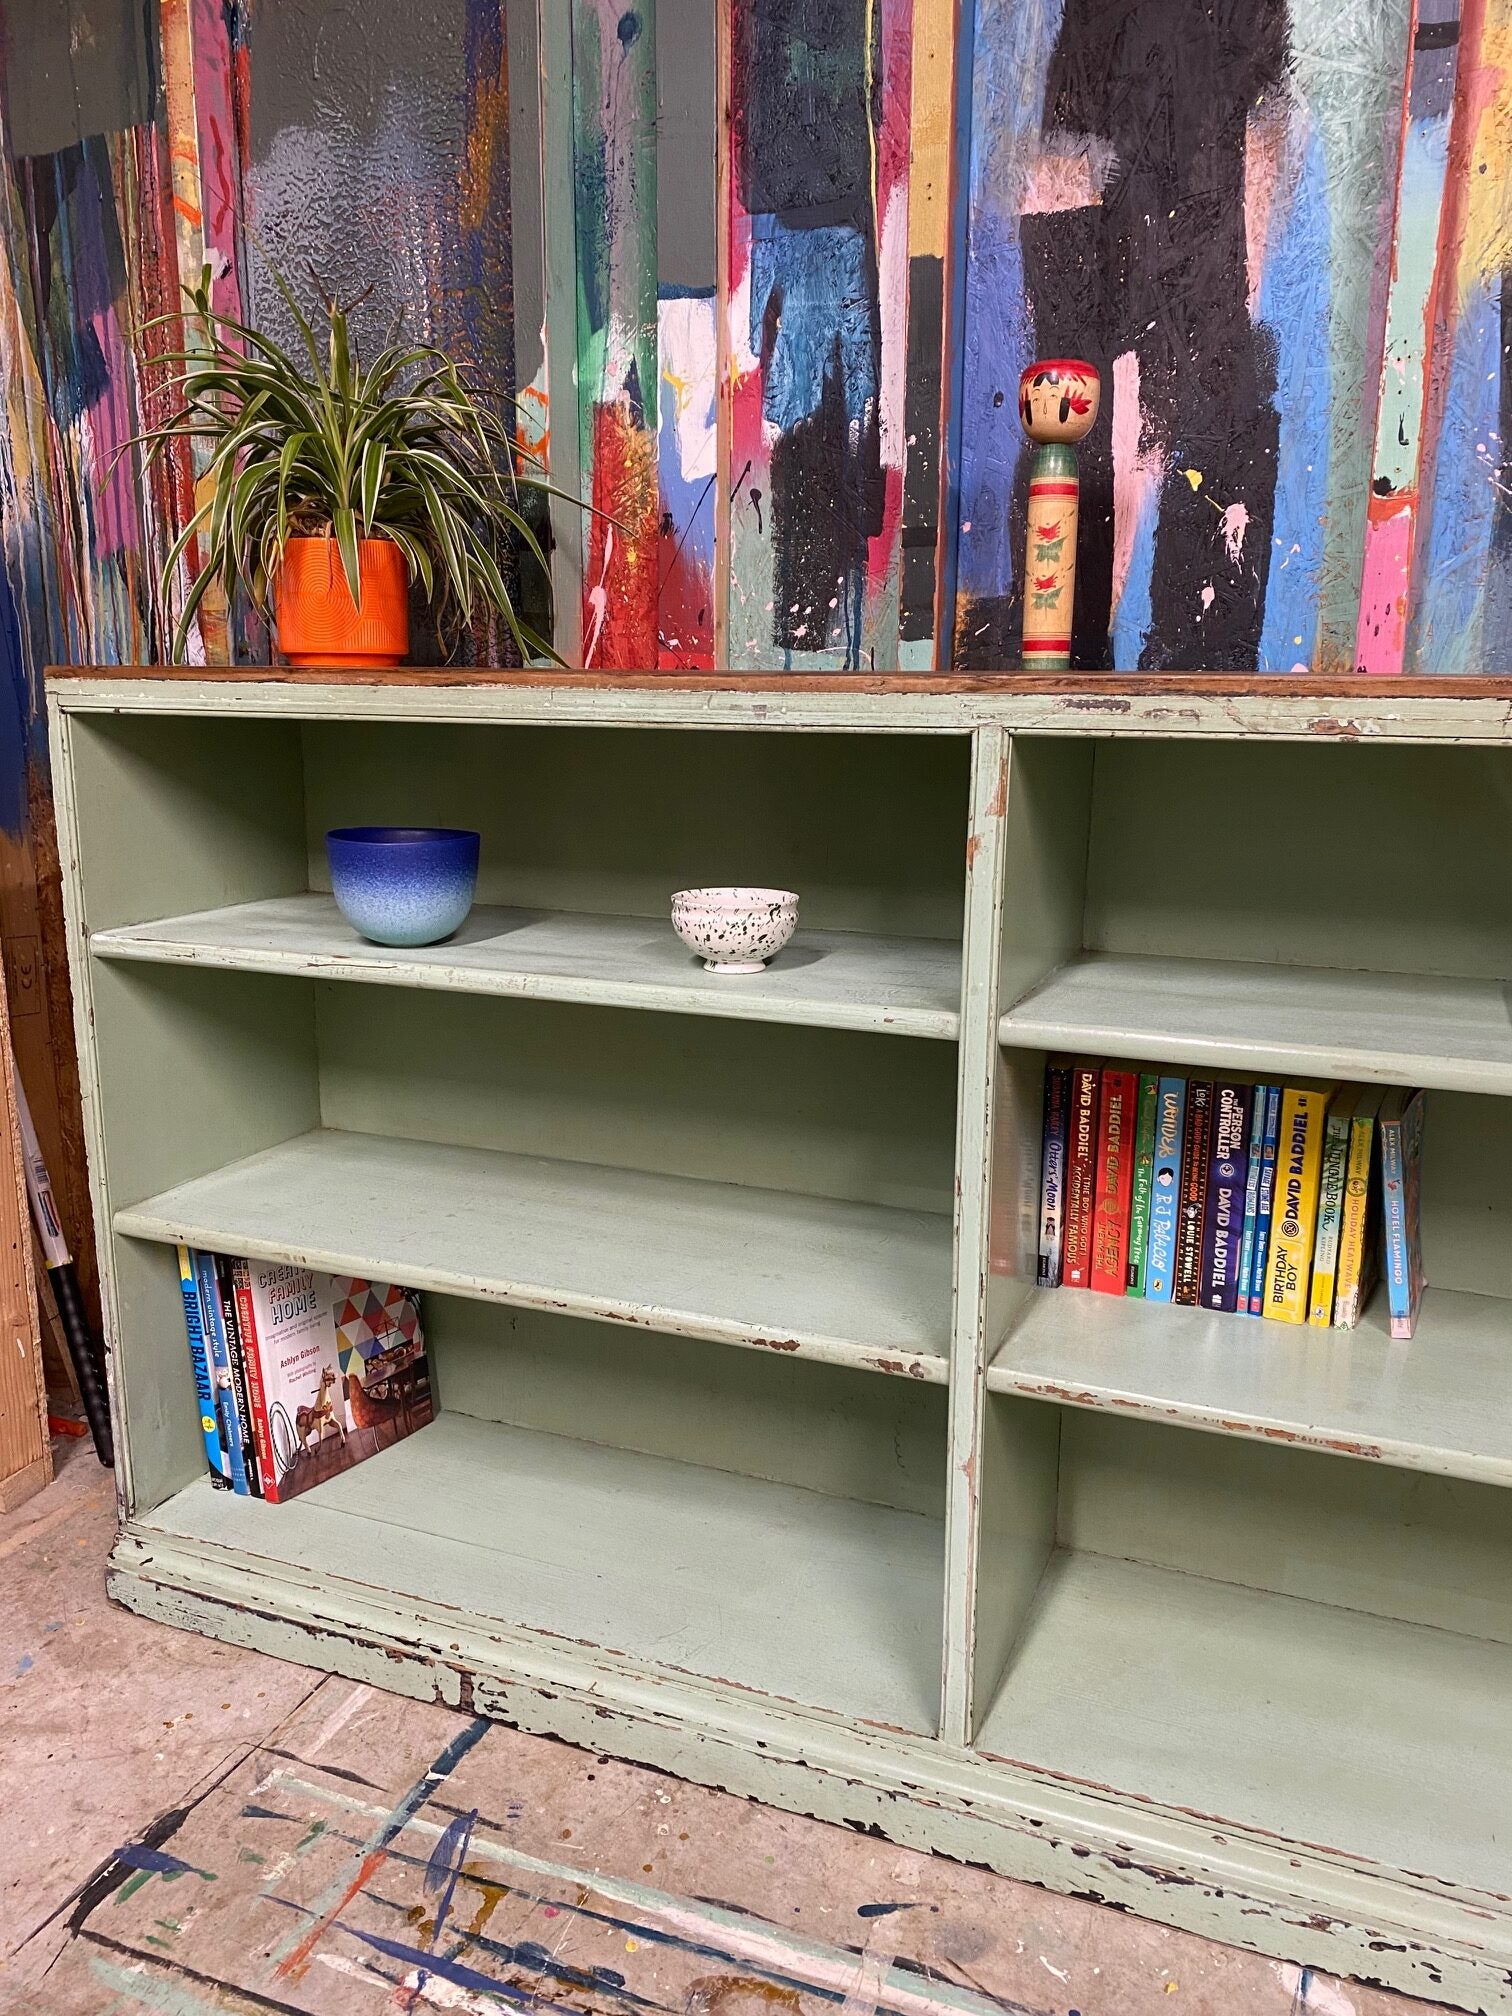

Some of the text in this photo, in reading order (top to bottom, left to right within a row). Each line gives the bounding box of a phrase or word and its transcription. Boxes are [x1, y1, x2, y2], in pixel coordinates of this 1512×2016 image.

[1078, 1074, 1092, 1158] DAVID BADDIEL
[1194, 1113, 1202, 1126] BAD
[1216, 1089, 1235, 1160] CONTROLLER
[1230, 1106, 1244, 1150] PERSON
[1106, 1094, 1122, 1194] DAVID BADDIEL
[1192, 1144, 1200, 1160] GUIDE
[1286, 1112, 1308, 1220] DAVID BADDIEL
[1046, 1179, 1058, 1210] Moon
[1190, 1182, 1198, 1200] GOOD
[1322, 1126, 1343, 1230] THE JUNGLE BOOK
[1067, 1166, 1081, 1265] ACCIDENTALLY FAMOUS
[1080, 1214, 1089, 1232] WHO
[1082, 1198, 1090, 1212] BOY
[1133, 1168, 1147, 1264] The Folk of the Faraway Tree
[1246, 1192, 1256, 1213] ROMANS
[1349, 1200, 1360, 1240] HOLIDAY
[1096, 1222, 1106, 1270] THE PARENT
[1104, 1220, 1120, 1278] AGENCY
[1183, 1220, 1196, 1282] LOUIE STOWELL
[1212, 1188, 1232, 1288] DAVID BADDIEL
[1325, 1236, 1334, 1264] RUDYARD
[1392, 1200, 1403, 1286] HOTEL FLAMINGO
[268, 1273, 314, 1304] FAMILY
[1273, 1246, 1288, 1304] BIRTHDAY
[1286, 1264, 1298, 1291] BOY
[1344, 1240, 1356, 1289] HEATWAVE
[202, 1270, 222, 1358] modern vintage style
[272, 1290, 316, 1326] HOME
[182, 1291, 211, 1401] BRIGHT BAZAAR
[280, 1345, 320, 1368] Ashlyn Gibson
[223, 1301, 250, 1444] THE VINTAGE MODERN HOME
[222, 1402, 234, 1447] Emily Chalmers
[257, 1418, 268, 1460] Ashlyn Gibson
